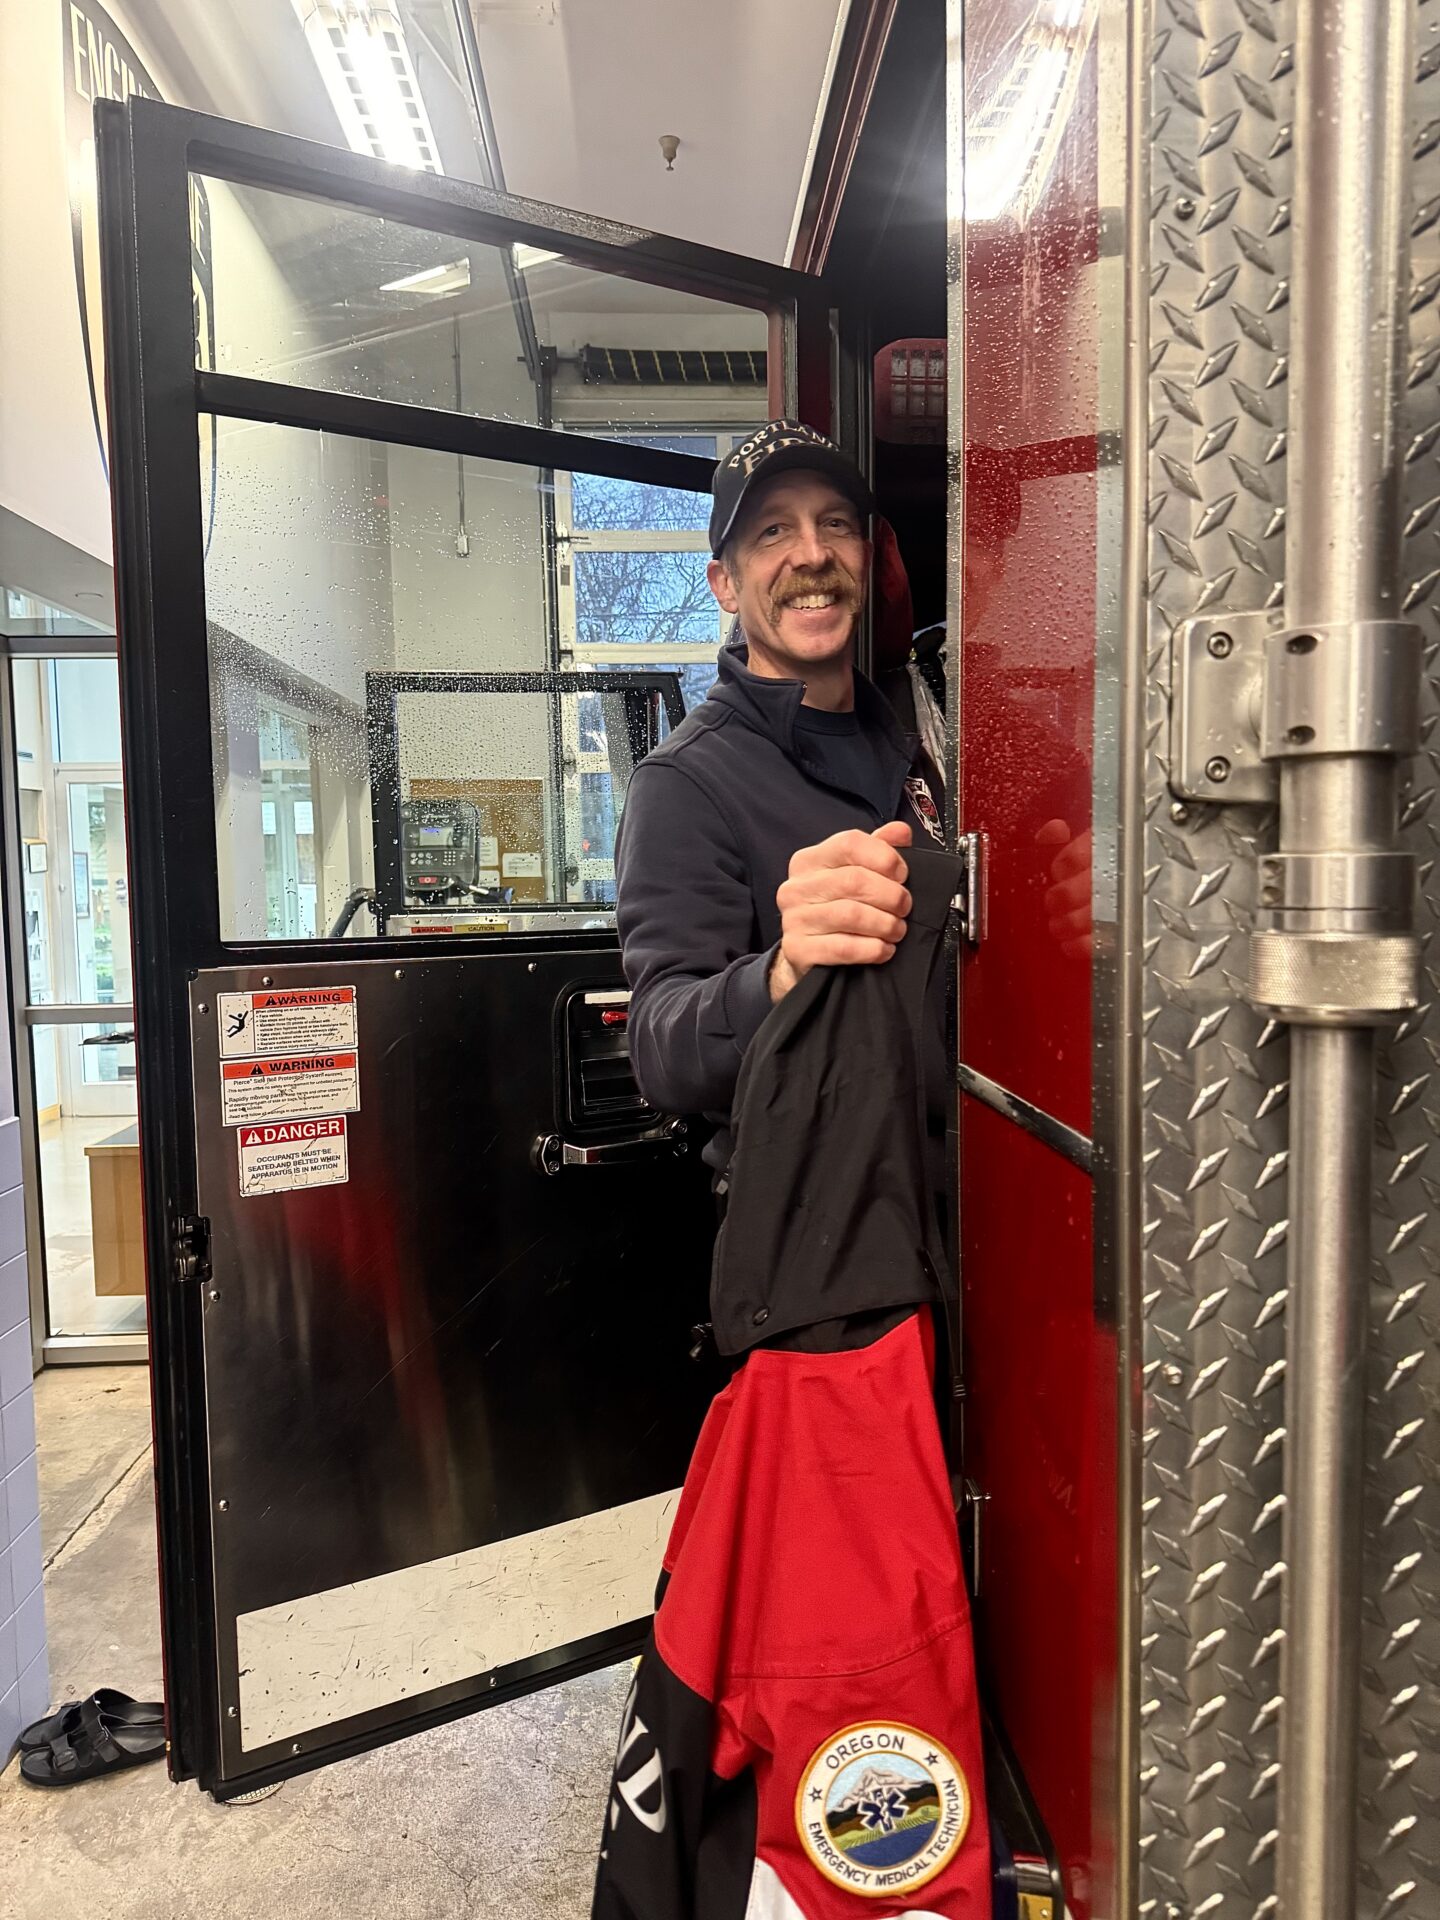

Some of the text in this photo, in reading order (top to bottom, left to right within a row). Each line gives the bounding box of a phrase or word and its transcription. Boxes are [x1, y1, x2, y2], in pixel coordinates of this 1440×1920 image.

[728, 420, 839, 468] PORTLAND
[278, 993, 340, 1005] WARNING
[269, 1058, 335, 1072] WARNING
[264, 1121, 340, 1142] DANGER
[248, 1164, 274, 1172] SEATED
[293, 1158, 318, 1166] BELTED
[320, 1155, 340, 1163] WHEN
[257, 1152, 300, 1163] OCCUPANTS
[251, 1169, 292, 1180] APPARATUS
[311, 1163, 338, 1171] MOTION
[826, 1733, 905, 1770] OREGON
[809, 1778, 960, 1886] EMERGENCY MEDICAL TECHNICIAN
